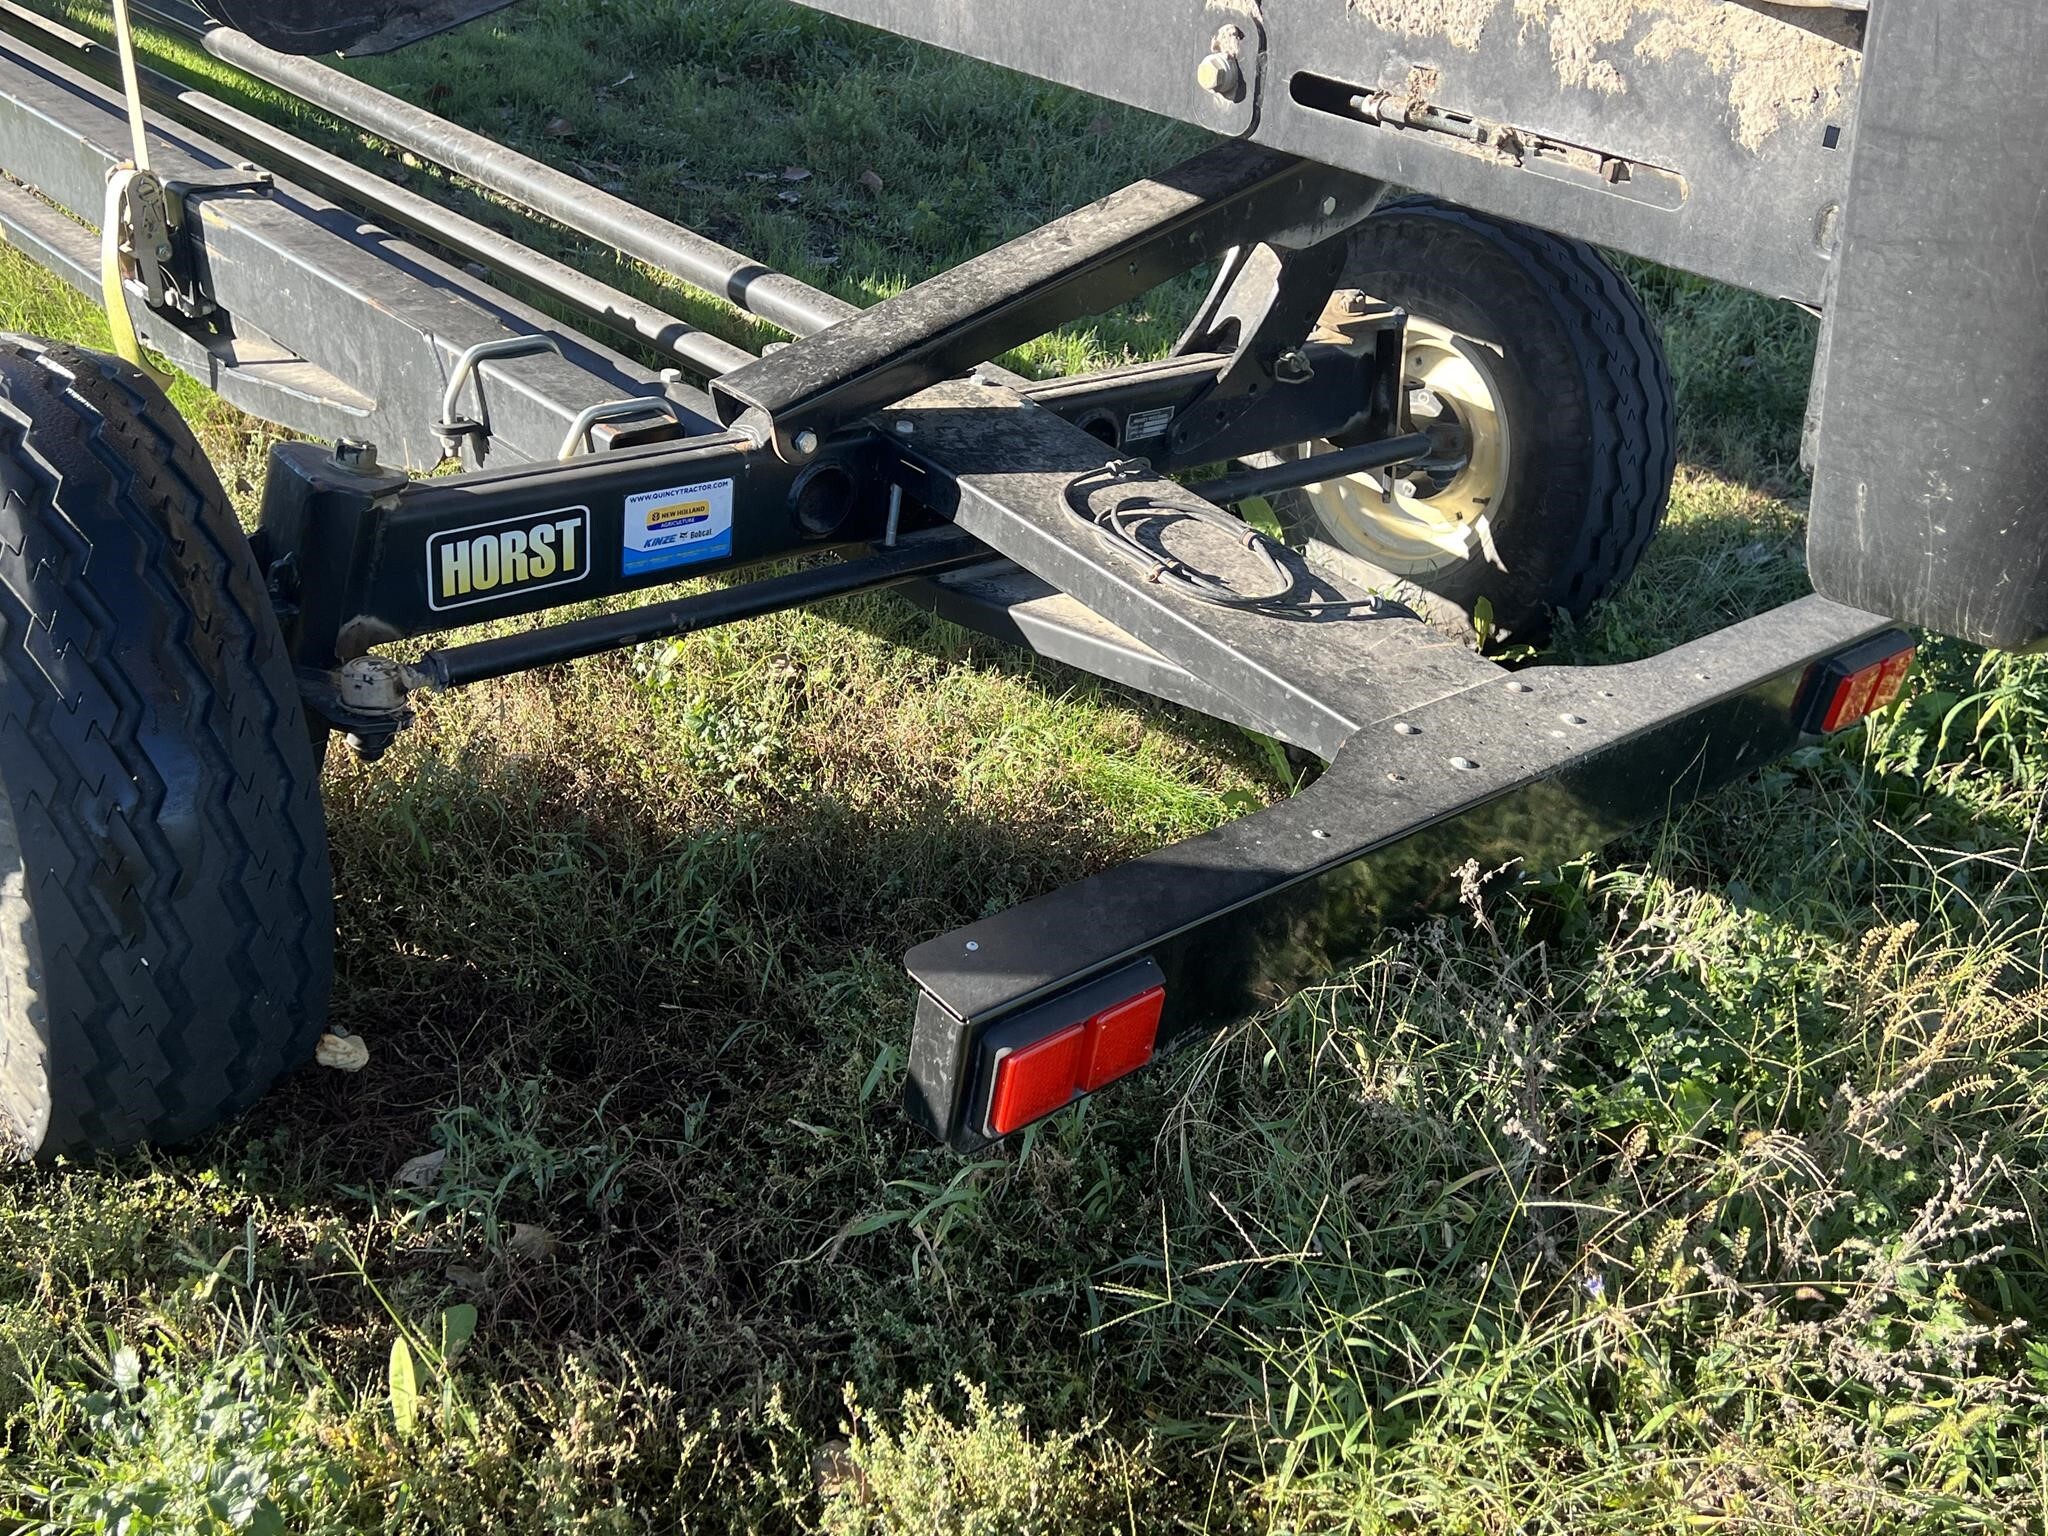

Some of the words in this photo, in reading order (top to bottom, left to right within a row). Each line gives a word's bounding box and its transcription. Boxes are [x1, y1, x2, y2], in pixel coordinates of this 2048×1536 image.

[629, 480, 729, 503] WWW.QUINCYTRACTOR.COM
[661, 510, 676, 519] NEW
[676, 505, 705, 516] HOLLAND
[660, 517, 695, 528] AGRICULTURE
[643, 533, 678, 549] KINZE
[690, 528, 713, 539] Bobcat
[440, 516, 582, 598] HORST
